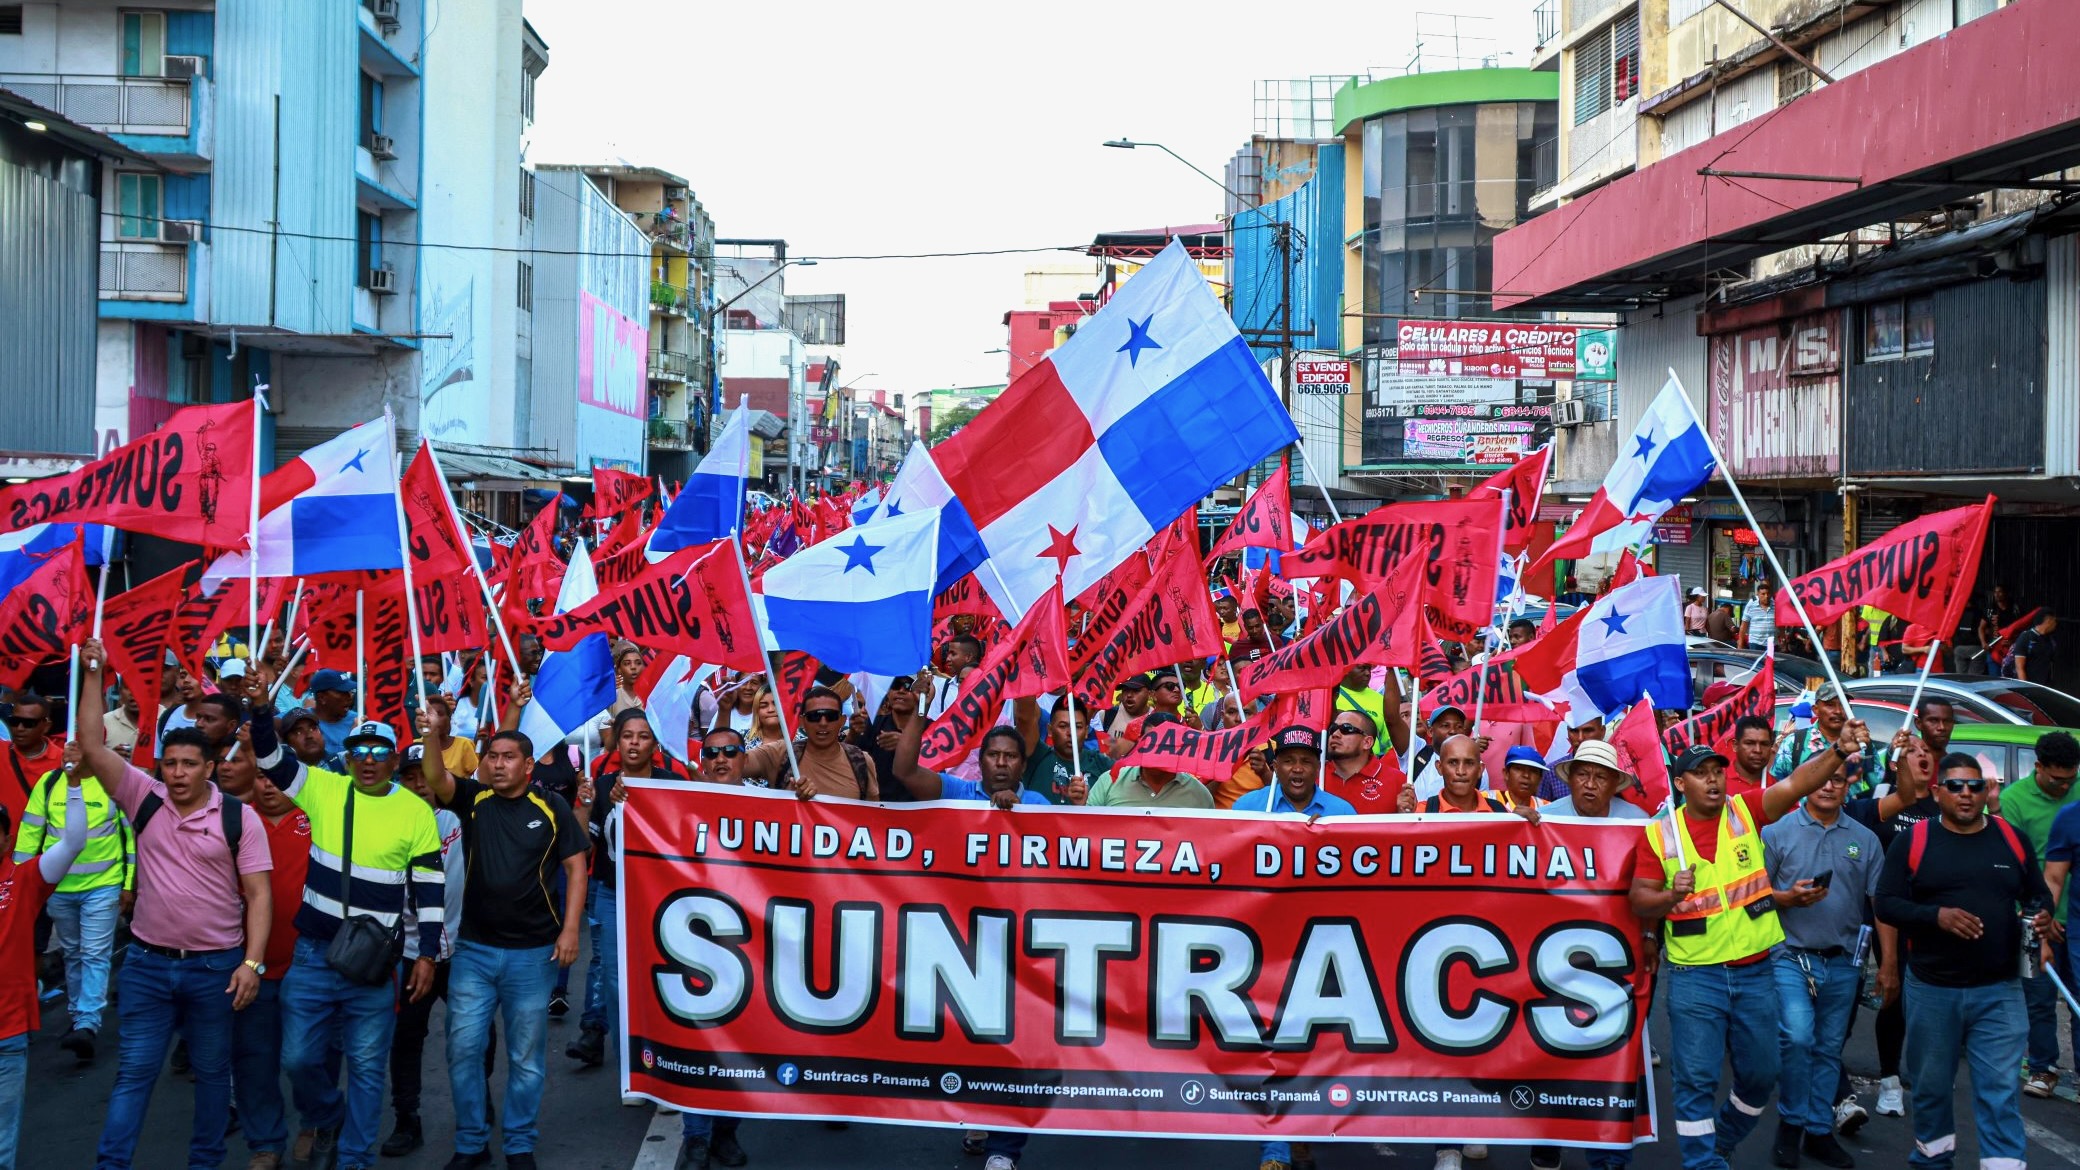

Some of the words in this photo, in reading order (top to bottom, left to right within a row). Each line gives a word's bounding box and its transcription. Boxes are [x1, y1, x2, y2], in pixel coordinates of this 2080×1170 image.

[1400, 325, 1488, 342] CELULARES
[1491, 329, 1501, 343] A
[1505, 326, 1575, 345] CRÉDITO
[1400, 341, 1415, 351] Solo
[1469, 343, 1483, 354] chip
[1544, 345, 1574, 356] Técnicos
[1298, 363, 1311, 372] SE
[1313, 363, 1348, 372] VENDE
[1503, 365, 1516, 374] LG
[1302, 373, 1345, 383] EDIFICIO
[694, 816, 936, 870] ¡UNIDAD,
[965, 832, 1223, 883] FIRMEZA,
[1253, 841, 1598, 882] DISCIPLINA!
[651, 887, 1638, 1059] SUNTRACS
[656, 1055, 705, 1076] Suntracs
[709, 1065, 766, 1080] Panamá
[803, 1069, 869, 1084] Suntracs
[872, 1073, 931, 1088] Panamá
[967, 1079, 1164, 1099] www.suntracspanama.com
[1209, 1088, 1267, 1101] Suntracs
[1270, 1089, 1321, 1102] Panamá
[1356, 1090, 1438, 1102] SUNTRACS
[1443, 1091, 1501, 1104] Panamá
[1539, 1093, 1605, 1108] Suntracs
[1609, 1096, 1636, 1109] Pan
